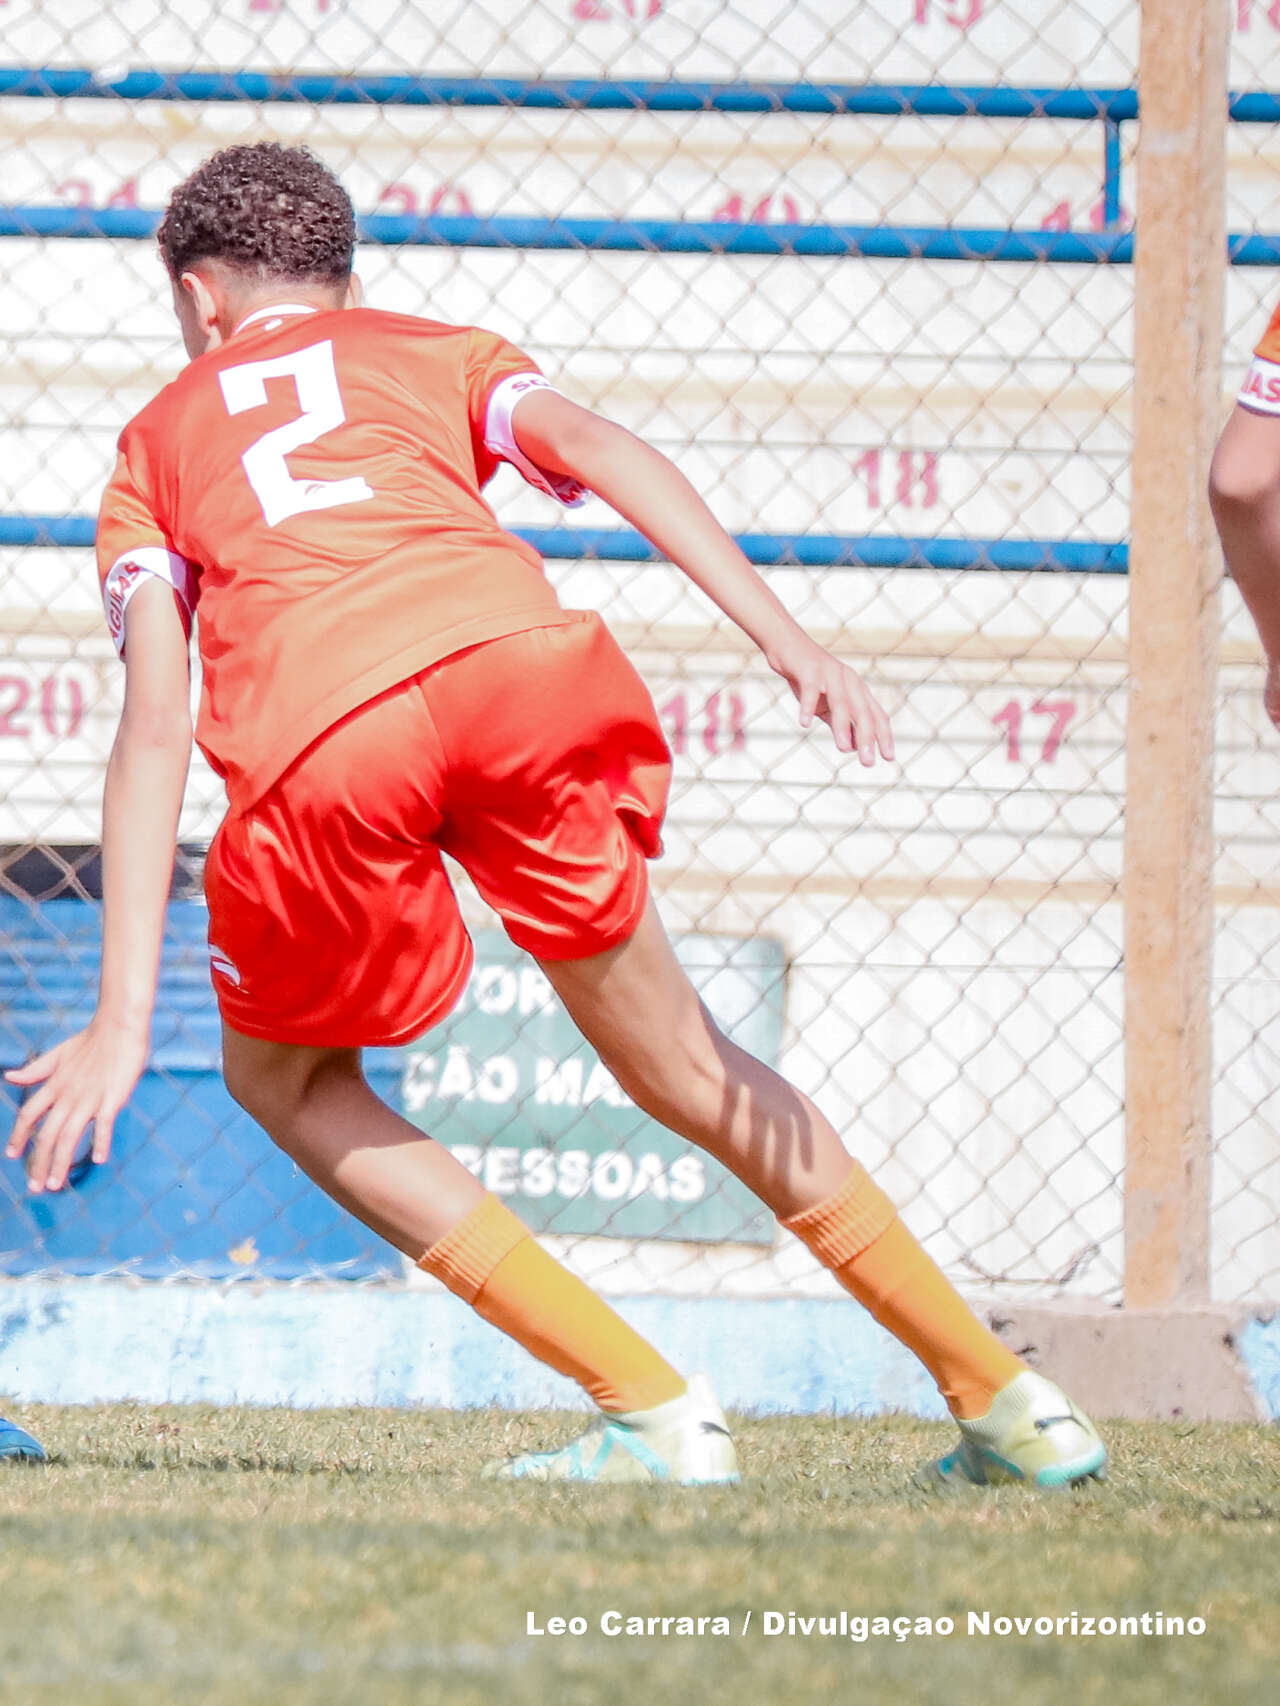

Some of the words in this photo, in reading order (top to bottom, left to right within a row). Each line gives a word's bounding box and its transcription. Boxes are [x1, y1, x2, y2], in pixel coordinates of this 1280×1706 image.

[219, 339, 374, 528] 2
[849, 448, 938, 508] 18
[659, 690, 745, 756] 18
[990, 699, 1076, 763] 17
